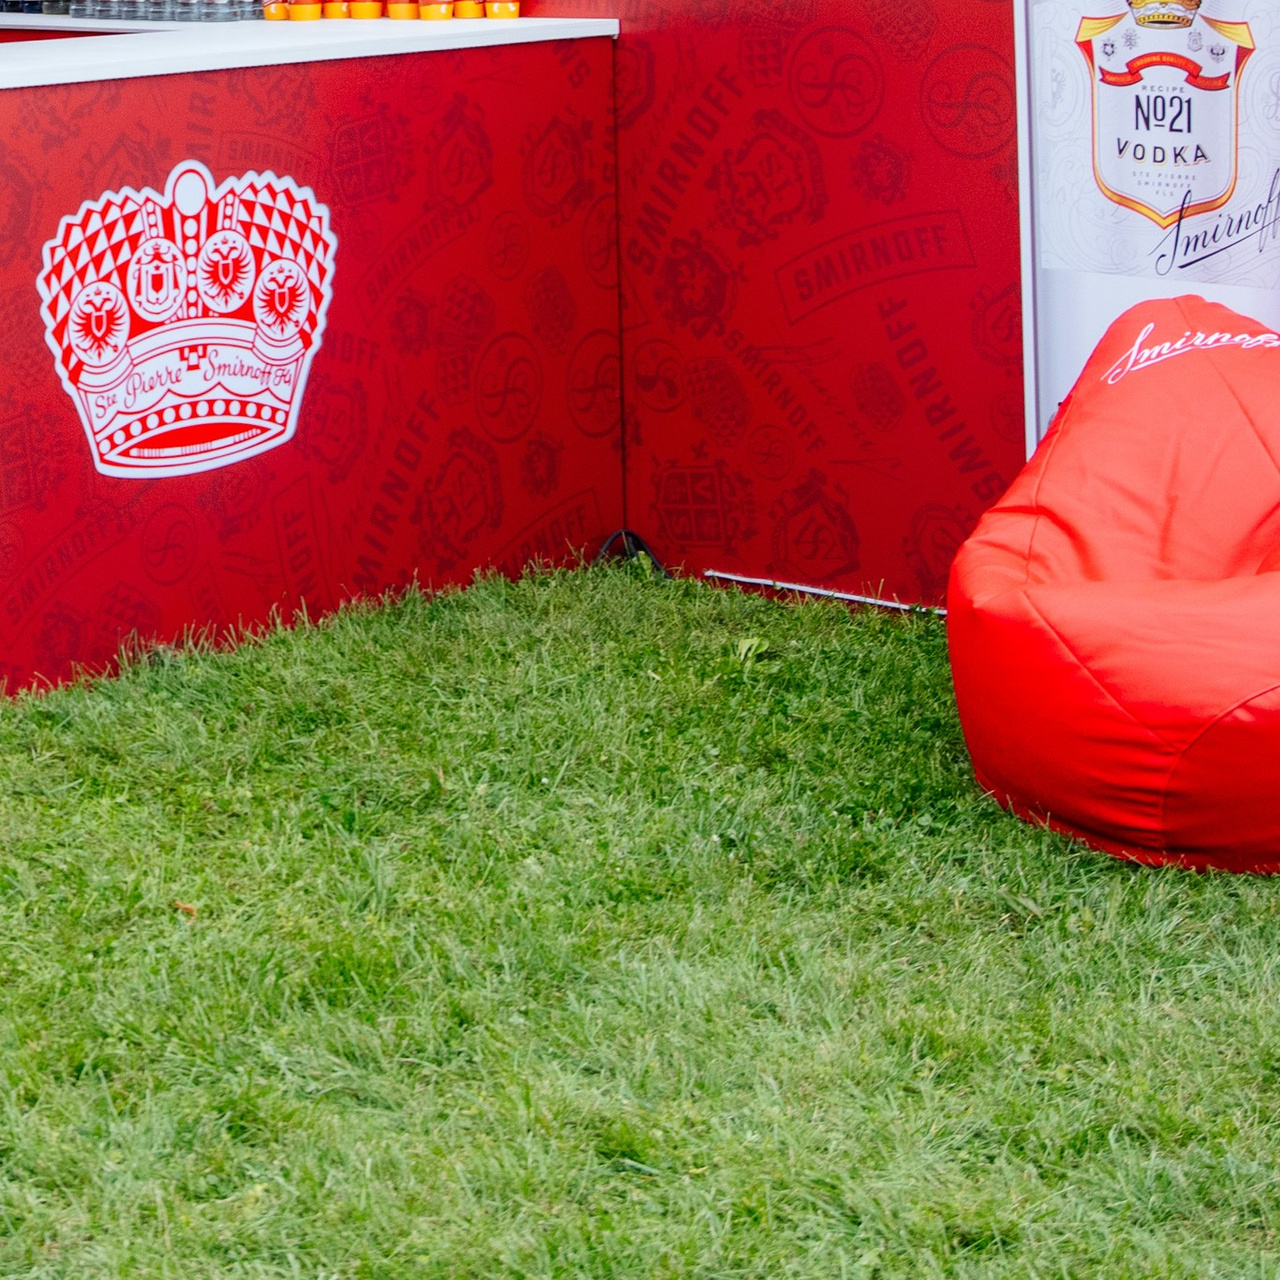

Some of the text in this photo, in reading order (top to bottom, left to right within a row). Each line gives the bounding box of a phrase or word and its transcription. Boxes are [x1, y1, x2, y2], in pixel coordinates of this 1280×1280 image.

[1141, 85, 1185, 93] RECIPE
[627, 63, 745, 277] SMIRNOFF
[1117, 137, 1211, 166] VODKA
[793, 223, 951, 302] SMIRNOFF
[95, 393, 117, 419] Ste
[124, 366, 182, 409] Pierre
[203, 348, 273, 386] Smirnoff
[877, 296, 1009, 504] SMIRNOFF
[5, 518, 108, 627] SMIRNOFF
